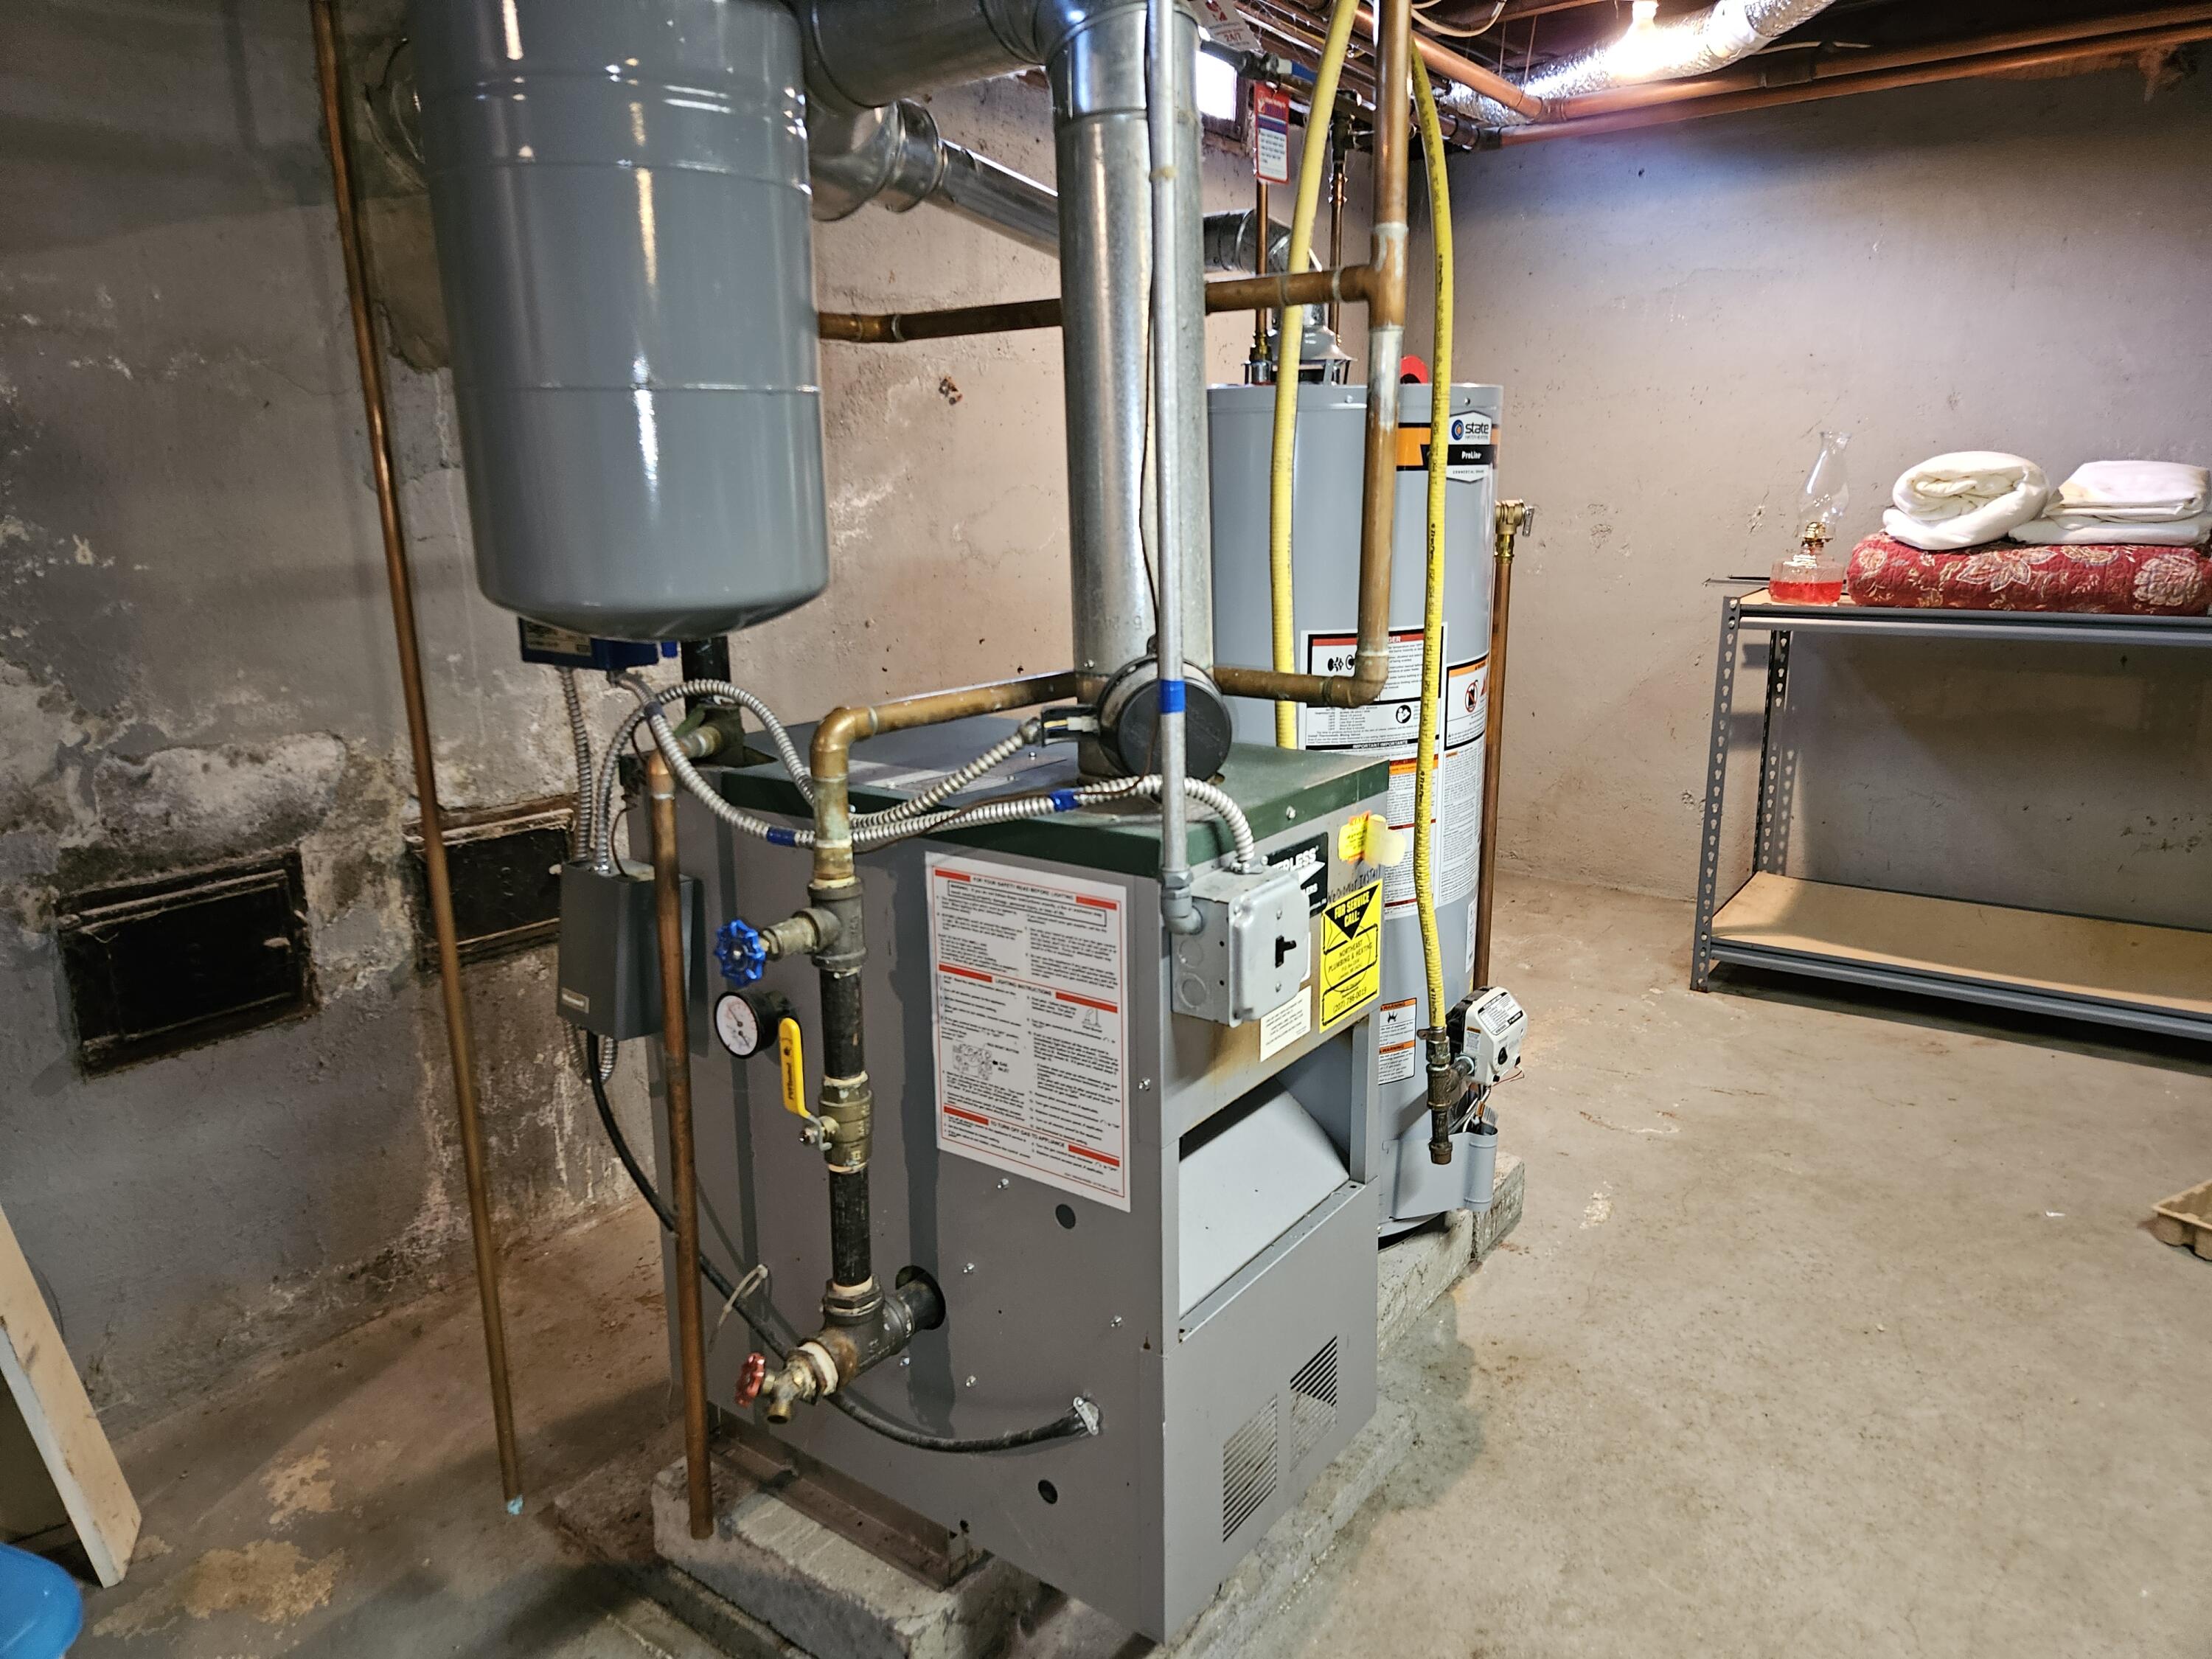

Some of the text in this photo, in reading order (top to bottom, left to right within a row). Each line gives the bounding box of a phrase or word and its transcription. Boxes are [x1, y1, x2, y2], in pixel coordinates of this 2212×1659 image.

[1465, 422, 1489, 434] state
[1271, 847, 1317, 871] RLESS
[1335, 903, 1346, 919] FOR
[1346, 891, 1370, 913] SERVICE
[1344, 911, 1360, 928] CALL:
[1328, 955, 1350, 973] PLUMBING
[1356, 942, 1372, 956] HEATING
[1340, 939, 1363, 957] NORTHEAST
